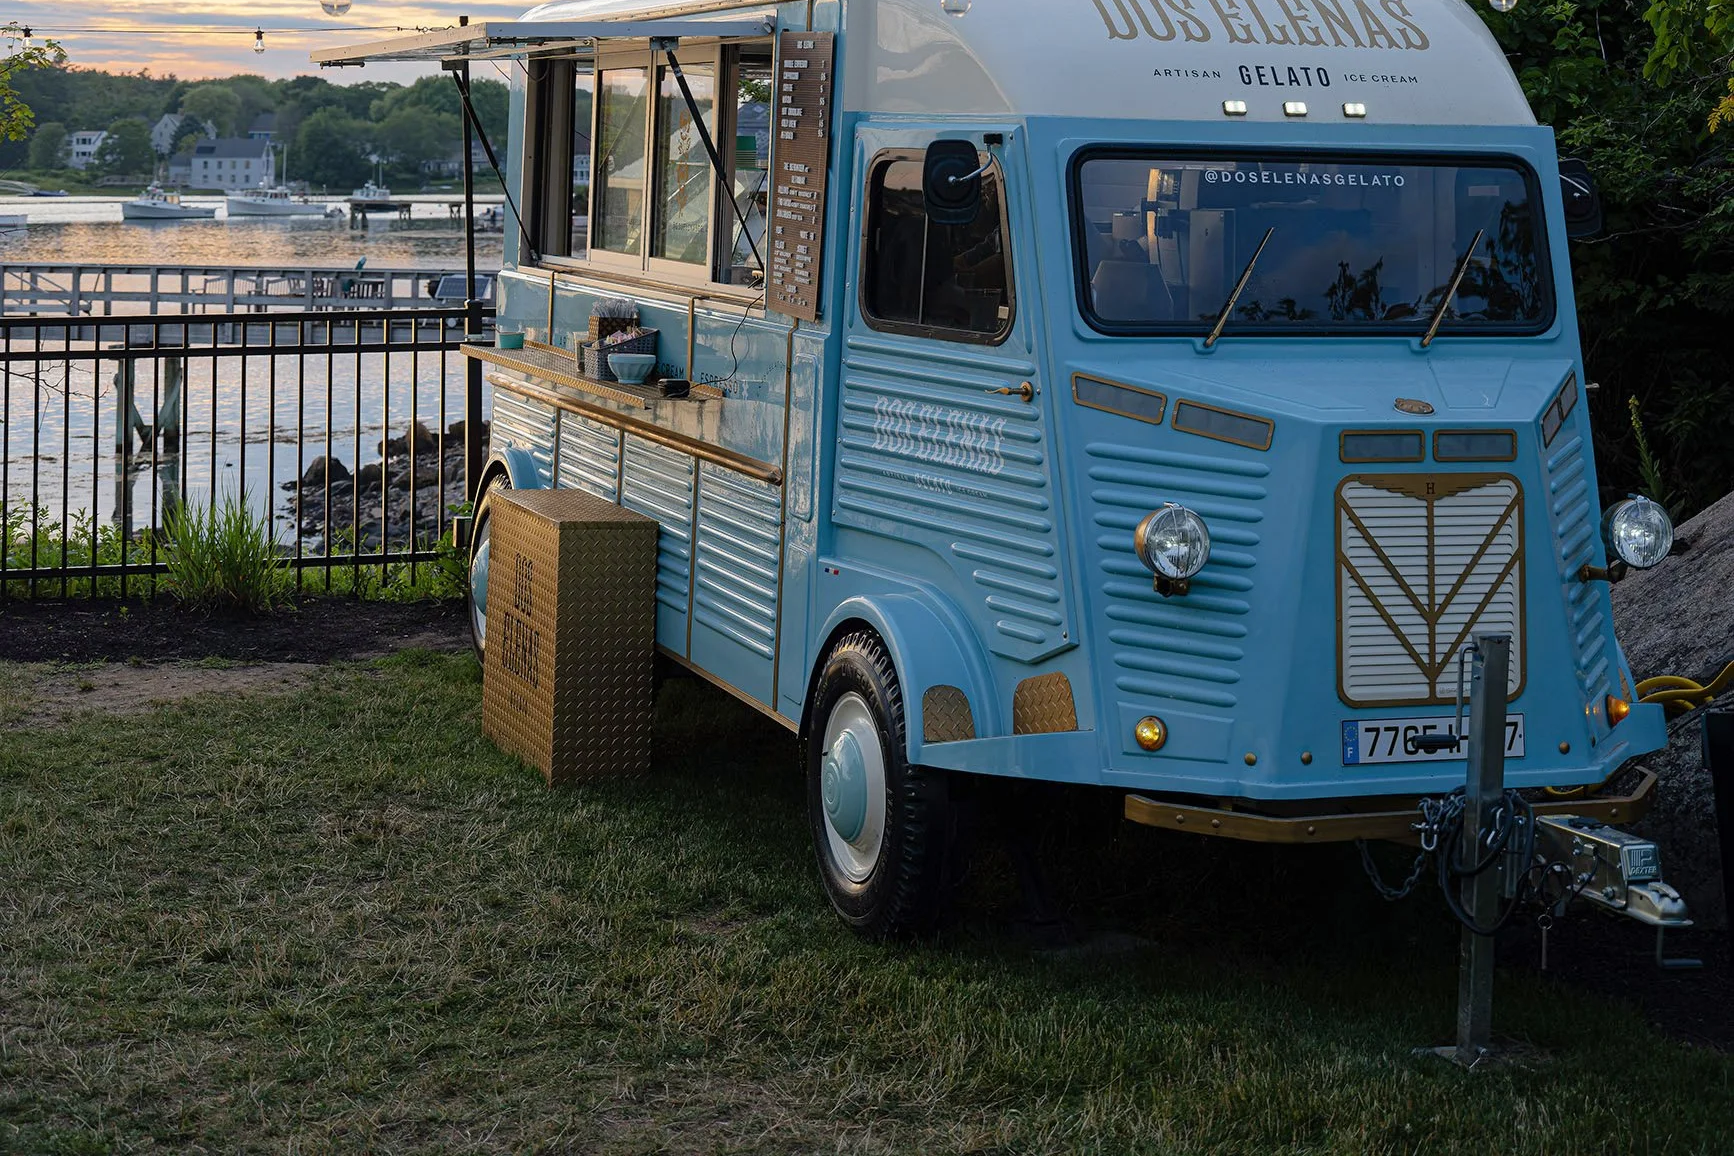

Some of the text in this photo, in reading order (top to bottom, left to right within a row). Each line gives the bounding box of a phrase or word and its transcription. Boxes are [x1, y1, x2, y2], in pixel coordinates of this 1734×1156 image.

[1153, 65, 1418, 87] ARTISAN GELATO ICE CREAM
[1204, 169, 1406, 187] @DOSELENASGELATO
[1426, 482, 1435, 494] H
[1347, 747, 1353, 758] F
